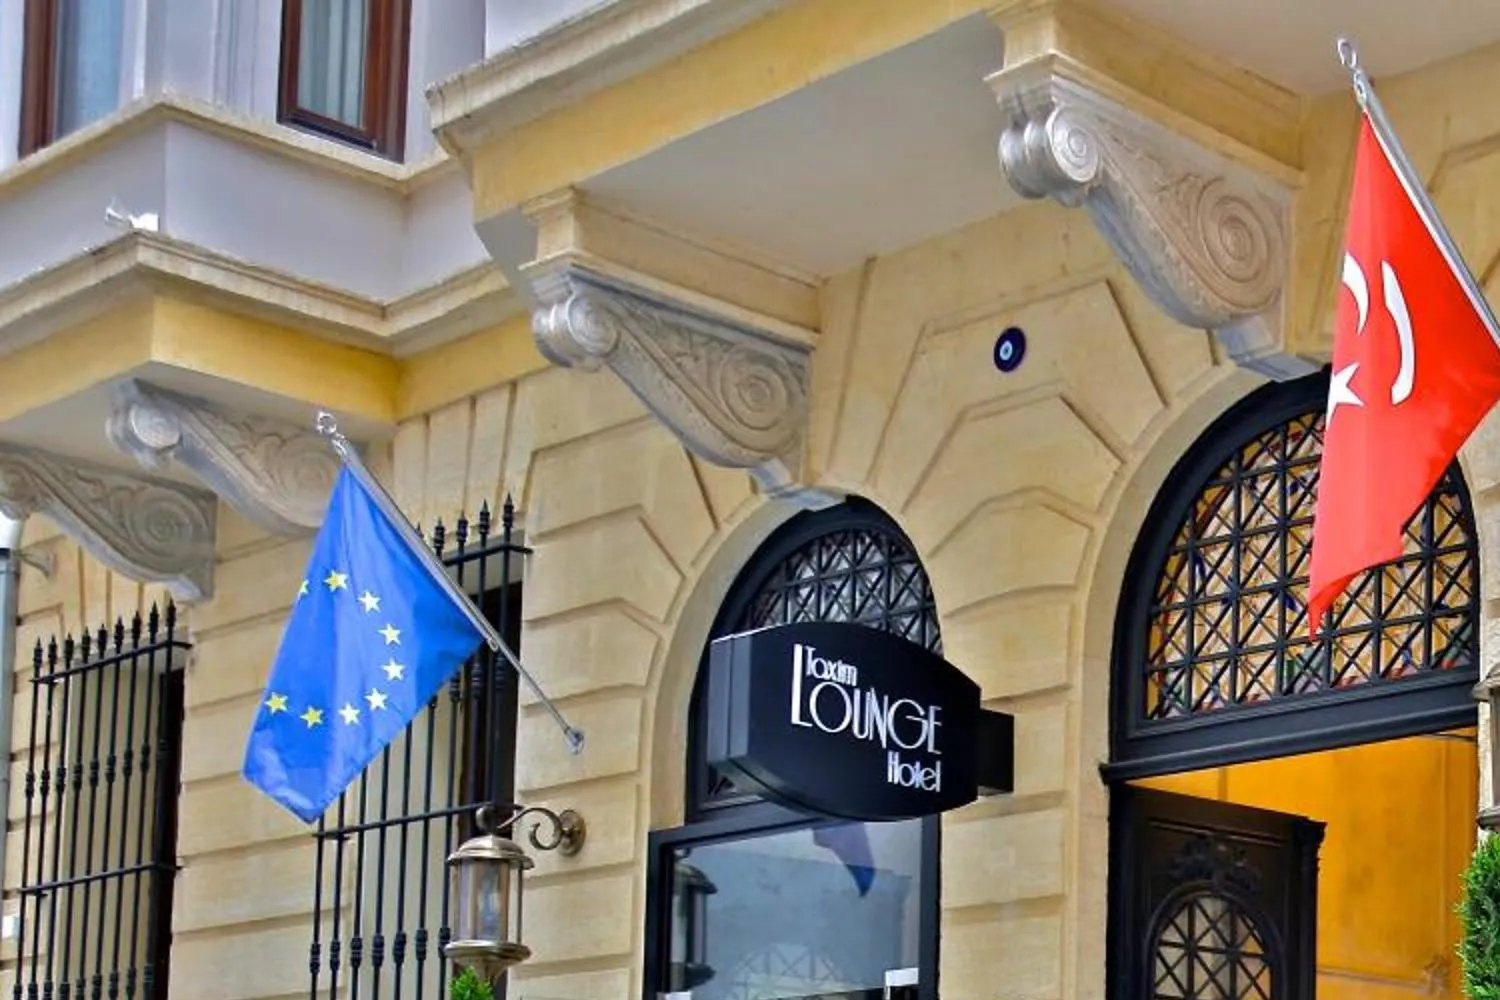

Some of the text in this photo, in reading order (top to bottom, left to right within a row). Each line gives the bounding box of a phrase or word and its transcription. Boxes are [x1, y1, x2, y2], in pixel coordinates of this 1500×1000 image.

[804, 645, 858, 687] Taxim
[791, 643, 942, 755] LOUNGE
[887, 751, 941, 792] Hotel
